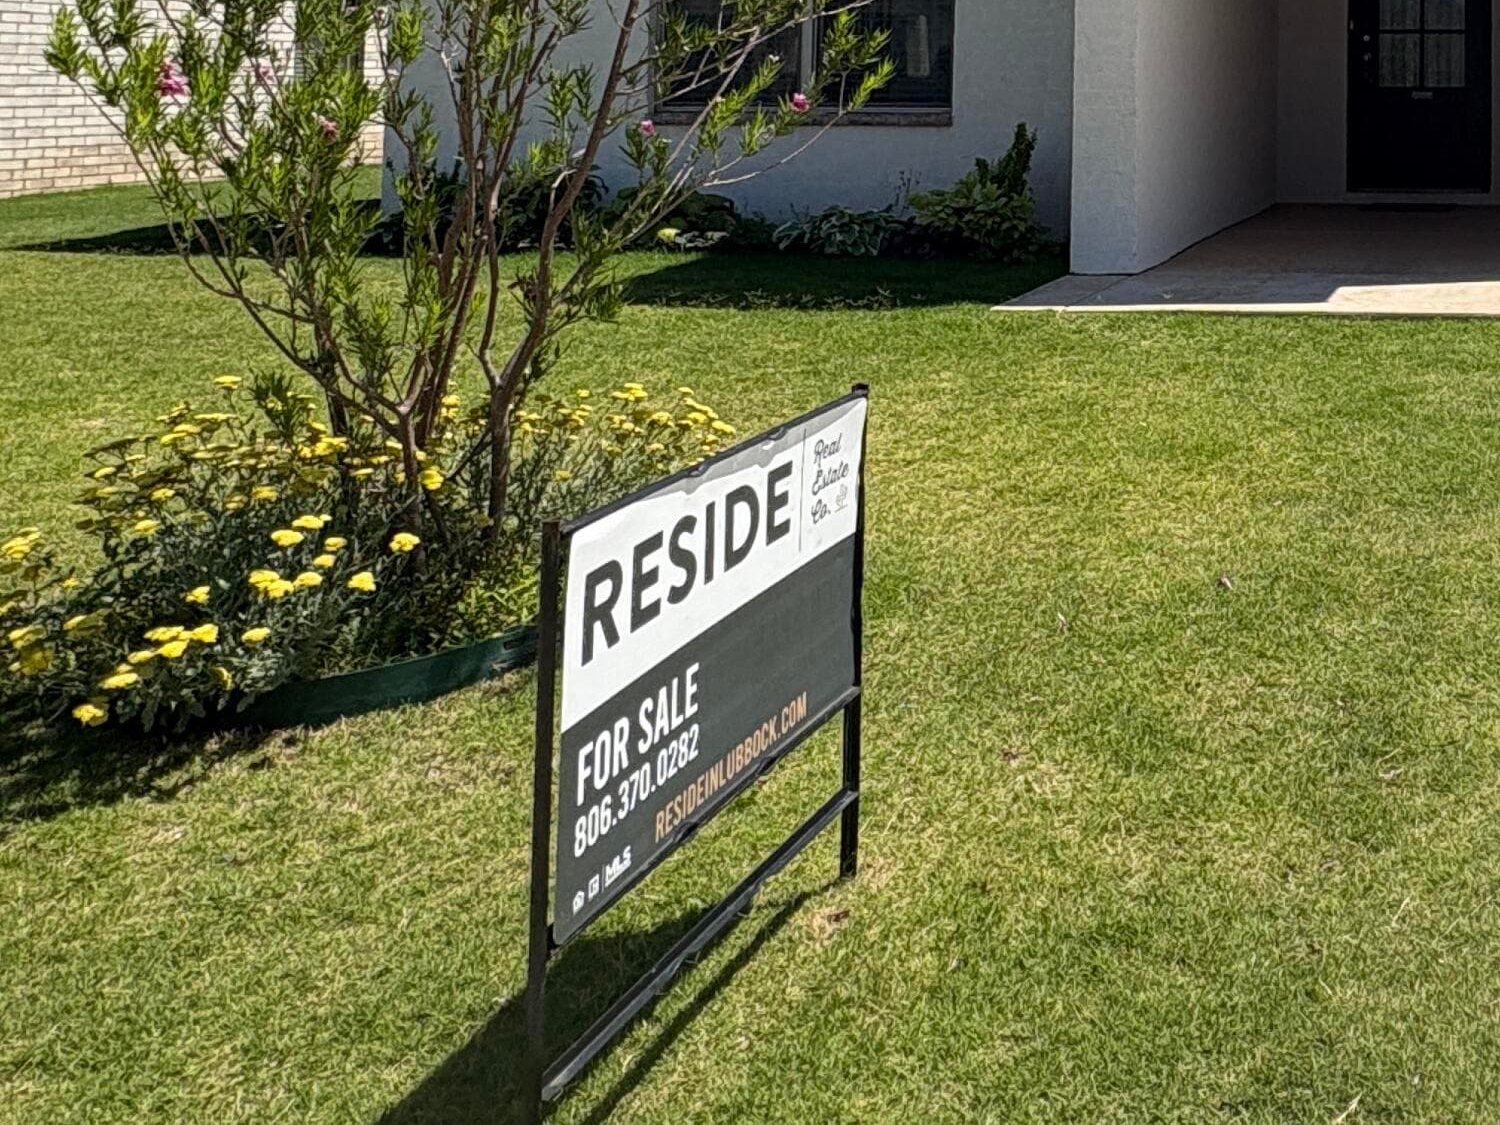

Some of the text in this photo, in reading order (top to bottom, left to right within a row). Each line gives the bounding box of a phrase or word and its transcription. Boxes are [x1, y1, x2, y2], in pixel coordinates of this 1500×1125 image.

[812, 462, 850, 496] Estate
[813, 432, 843, 465] Real
[810, 499, 831, 525] Co.
[581, 460, 794, 666] RESIDE
[576, 662, 700, 807] FOR SALE
[654, 691, 808, 844] RESIDEINLUBBOCK.COM
[574, 723, 700, 858] 806.370.0282
[605, 845, 632, 880] MLS
